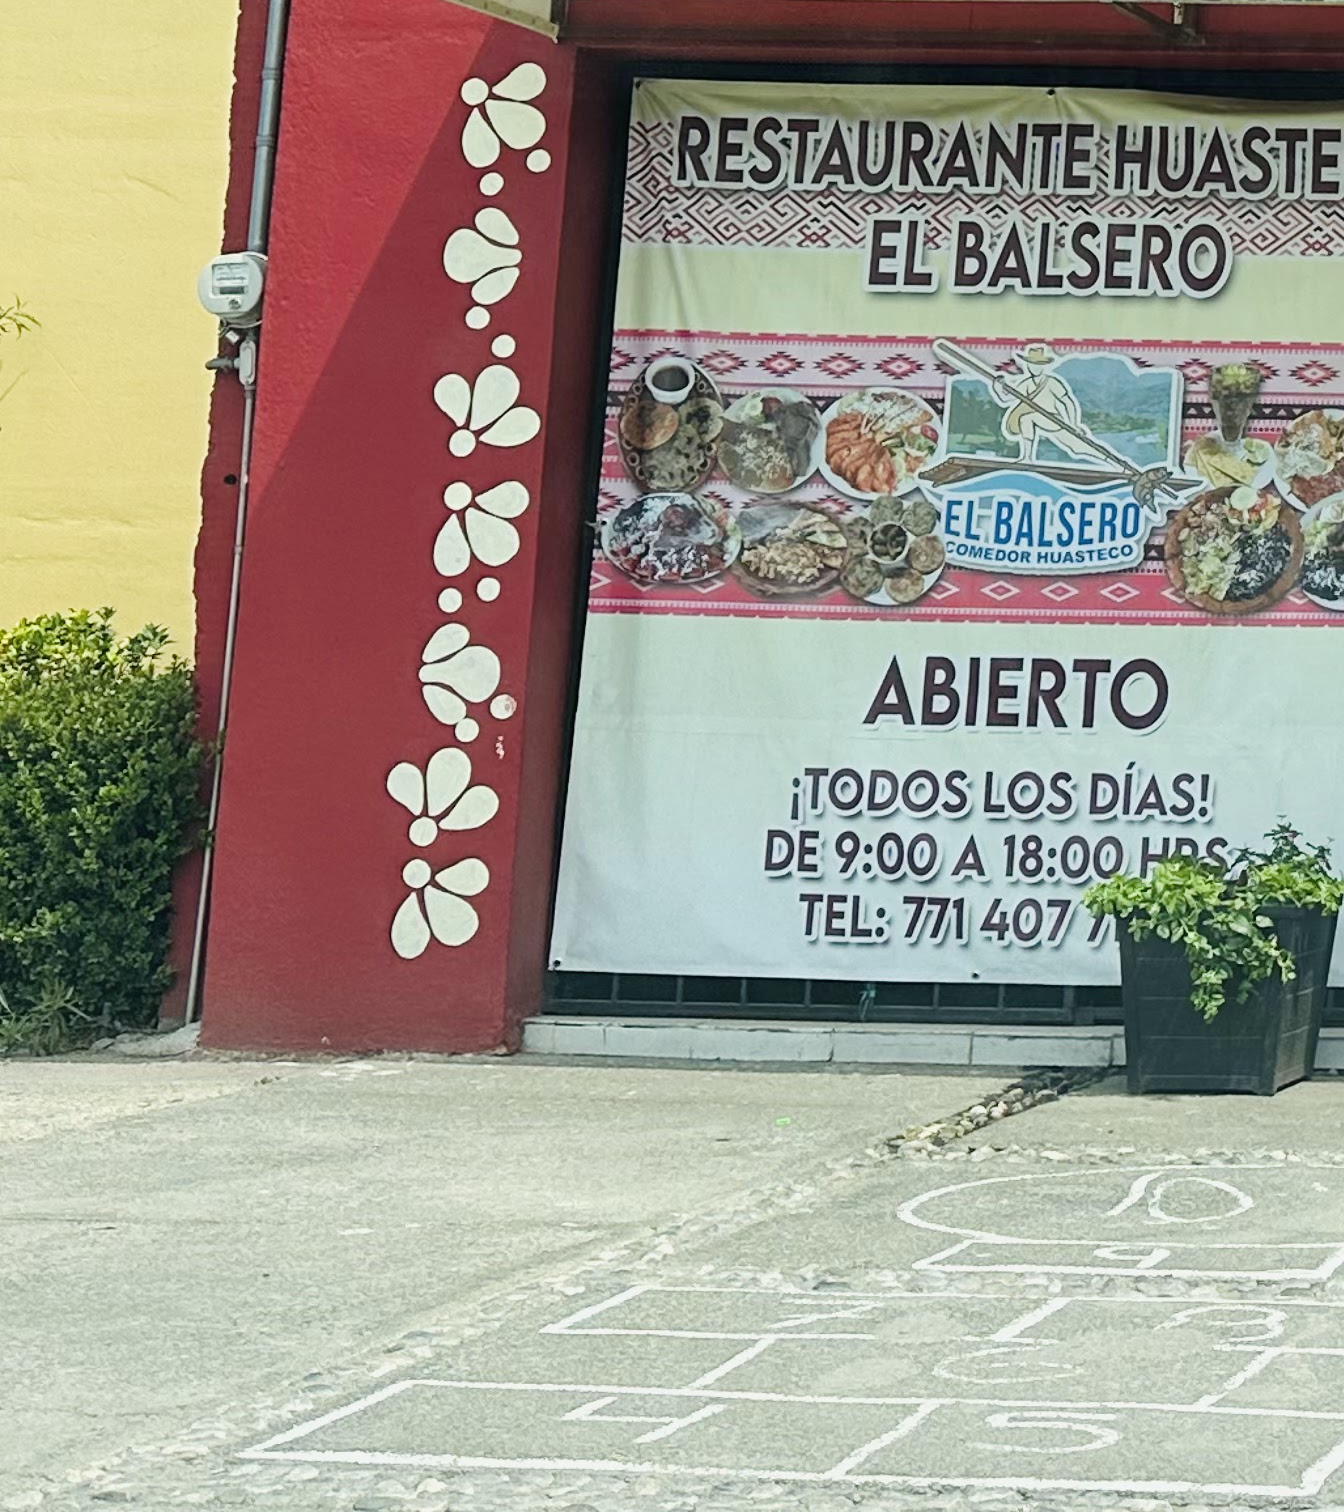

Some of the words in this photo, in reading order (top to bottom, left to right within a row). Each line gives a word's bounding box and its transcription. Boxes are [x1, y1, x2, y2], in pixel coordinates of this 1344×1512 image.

[676, 116, 1096, 190] RESTAURANTE
[867, 221, 934, 287] EL
[953, 220, 1230, 294] BALSERO
[945, 500, 980, 541] EL
[994, 501, 1140, 547] BALSERO
[946, 542, 1031, 563] COMEDOR
[1037, 544, 1133, 564] HUASTECO
[863, 655, 1169, 731] ABIERTO
[790, 767, 968, 820] ¡TODOS
[984, 771, 1072, 814] LOS
[1089, 761, 1210, 818] DÍAS!
[764, 829, 820, 872] DE
[835, 831, 937, 876] 9:00
[952, 834, 986, 877] A
[1004, 834, 1124, 879] 18:00
[799, 894, 885, 937] TEL:
[903, 896, 964, 940] 771
[980, 898, 1072, 942] 407
[562, 1396, 728, 1444] 4
[969, 1410, 1125, 1456] 5
